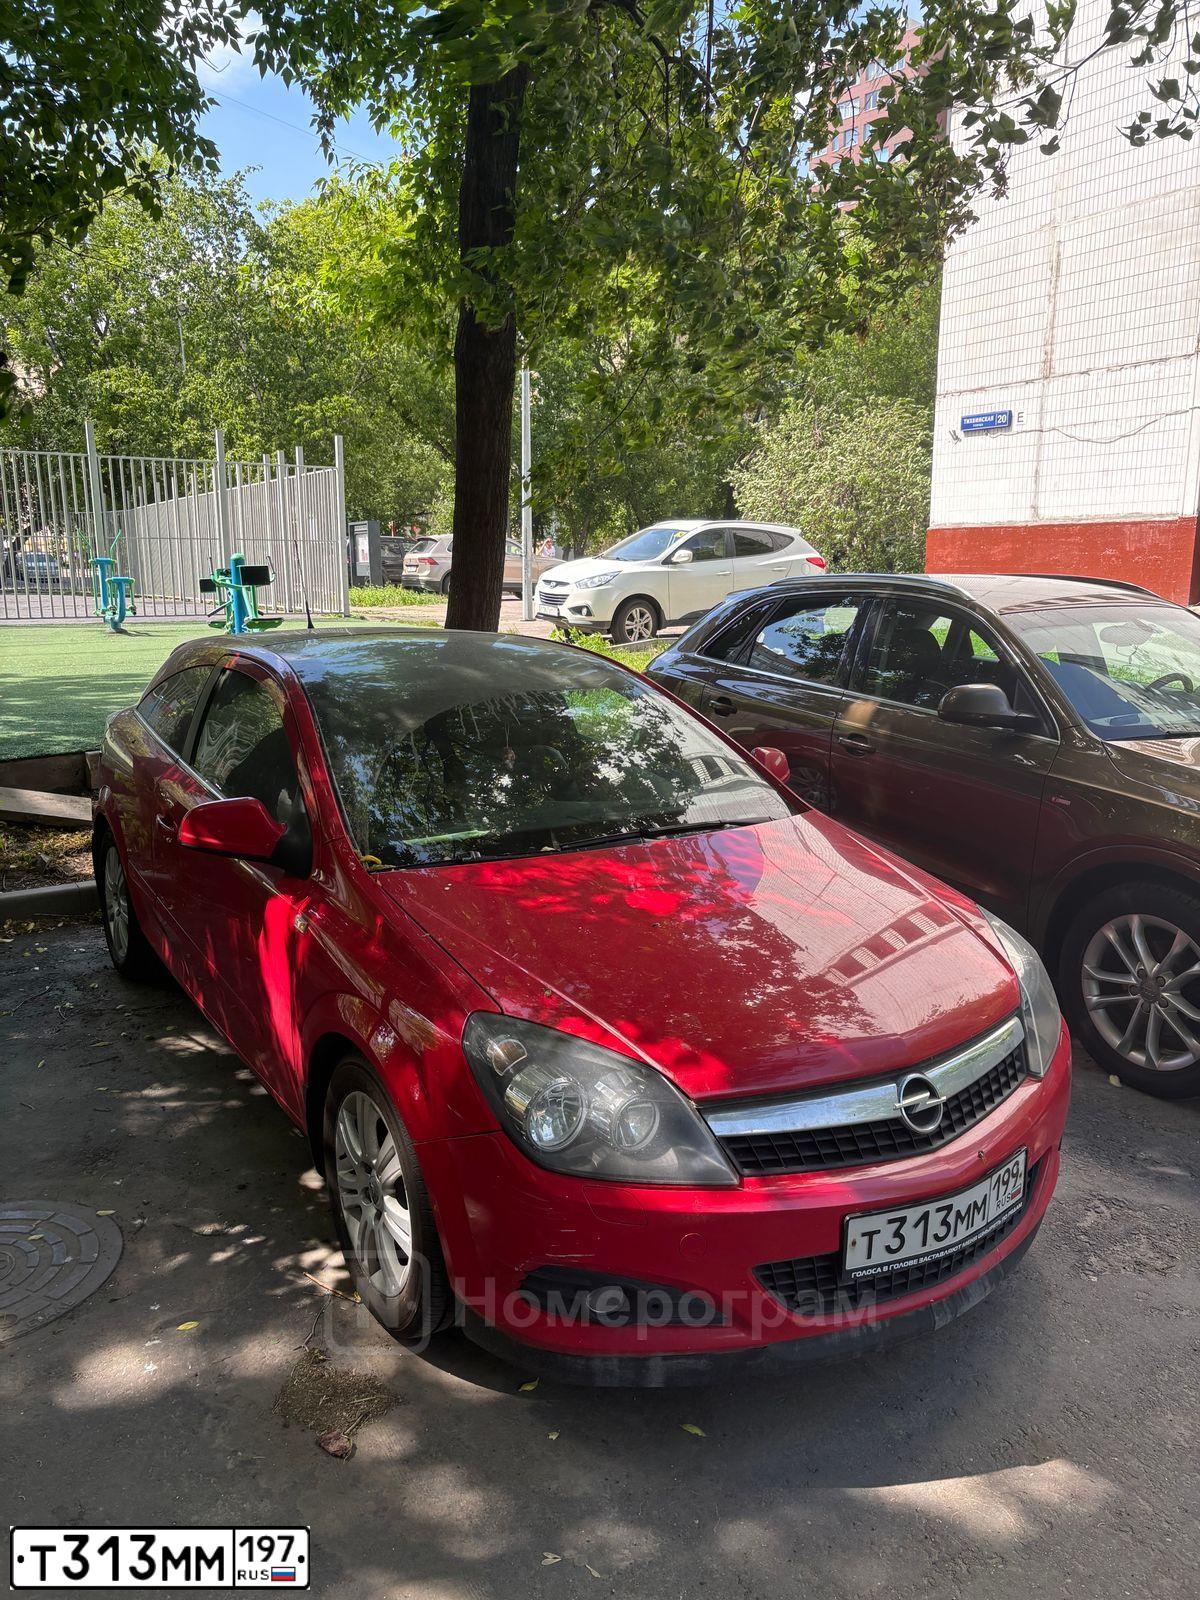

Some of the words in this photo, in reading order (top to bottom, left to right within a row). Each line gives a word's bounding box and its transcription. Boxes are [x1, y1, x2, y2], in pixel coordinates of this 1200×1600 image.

[998, 414, 1006, 424] 20
[861, 1193, 987, 1259] Т313ММ
[992, 1160, 1020, 1200] 199
[996, 1193, 1011, 1211] RUS
[851, 1266, 882, 1279] ГОЛОСА
[883, 1265, 889, 1273] В
[889, 1258, 918, 1271] ГОЛОВЕ
[918, 1244, 961, 1264] ЗАСТАВЛЯЮТ
